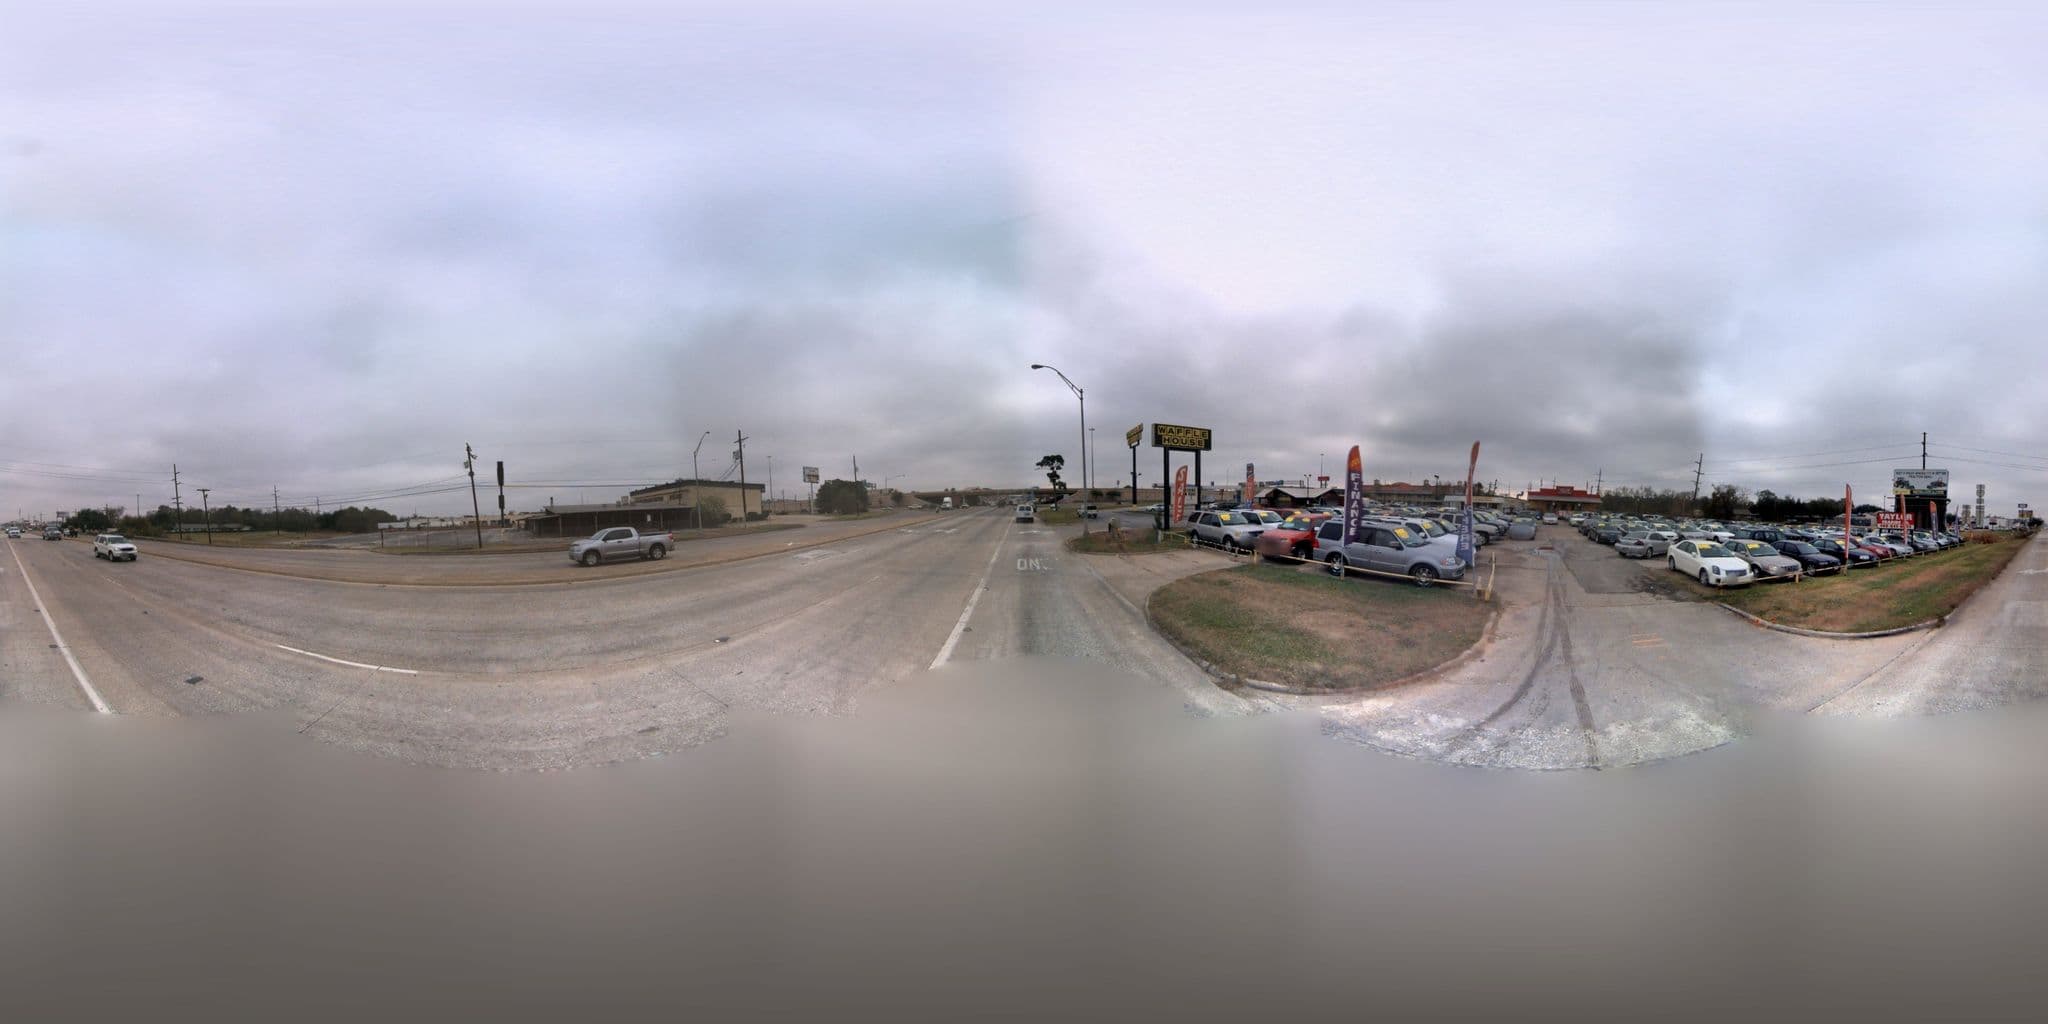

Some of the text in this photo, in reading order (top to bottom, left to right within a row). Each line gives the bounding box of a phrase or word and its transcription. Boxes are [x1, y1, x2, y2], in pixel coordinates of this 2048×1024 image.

[1158, 426, 1208, 438] WAFFLE
[1163, 436, 1204, 447] HOUSE
[1349, 473, 1361, 536] FINANCE
